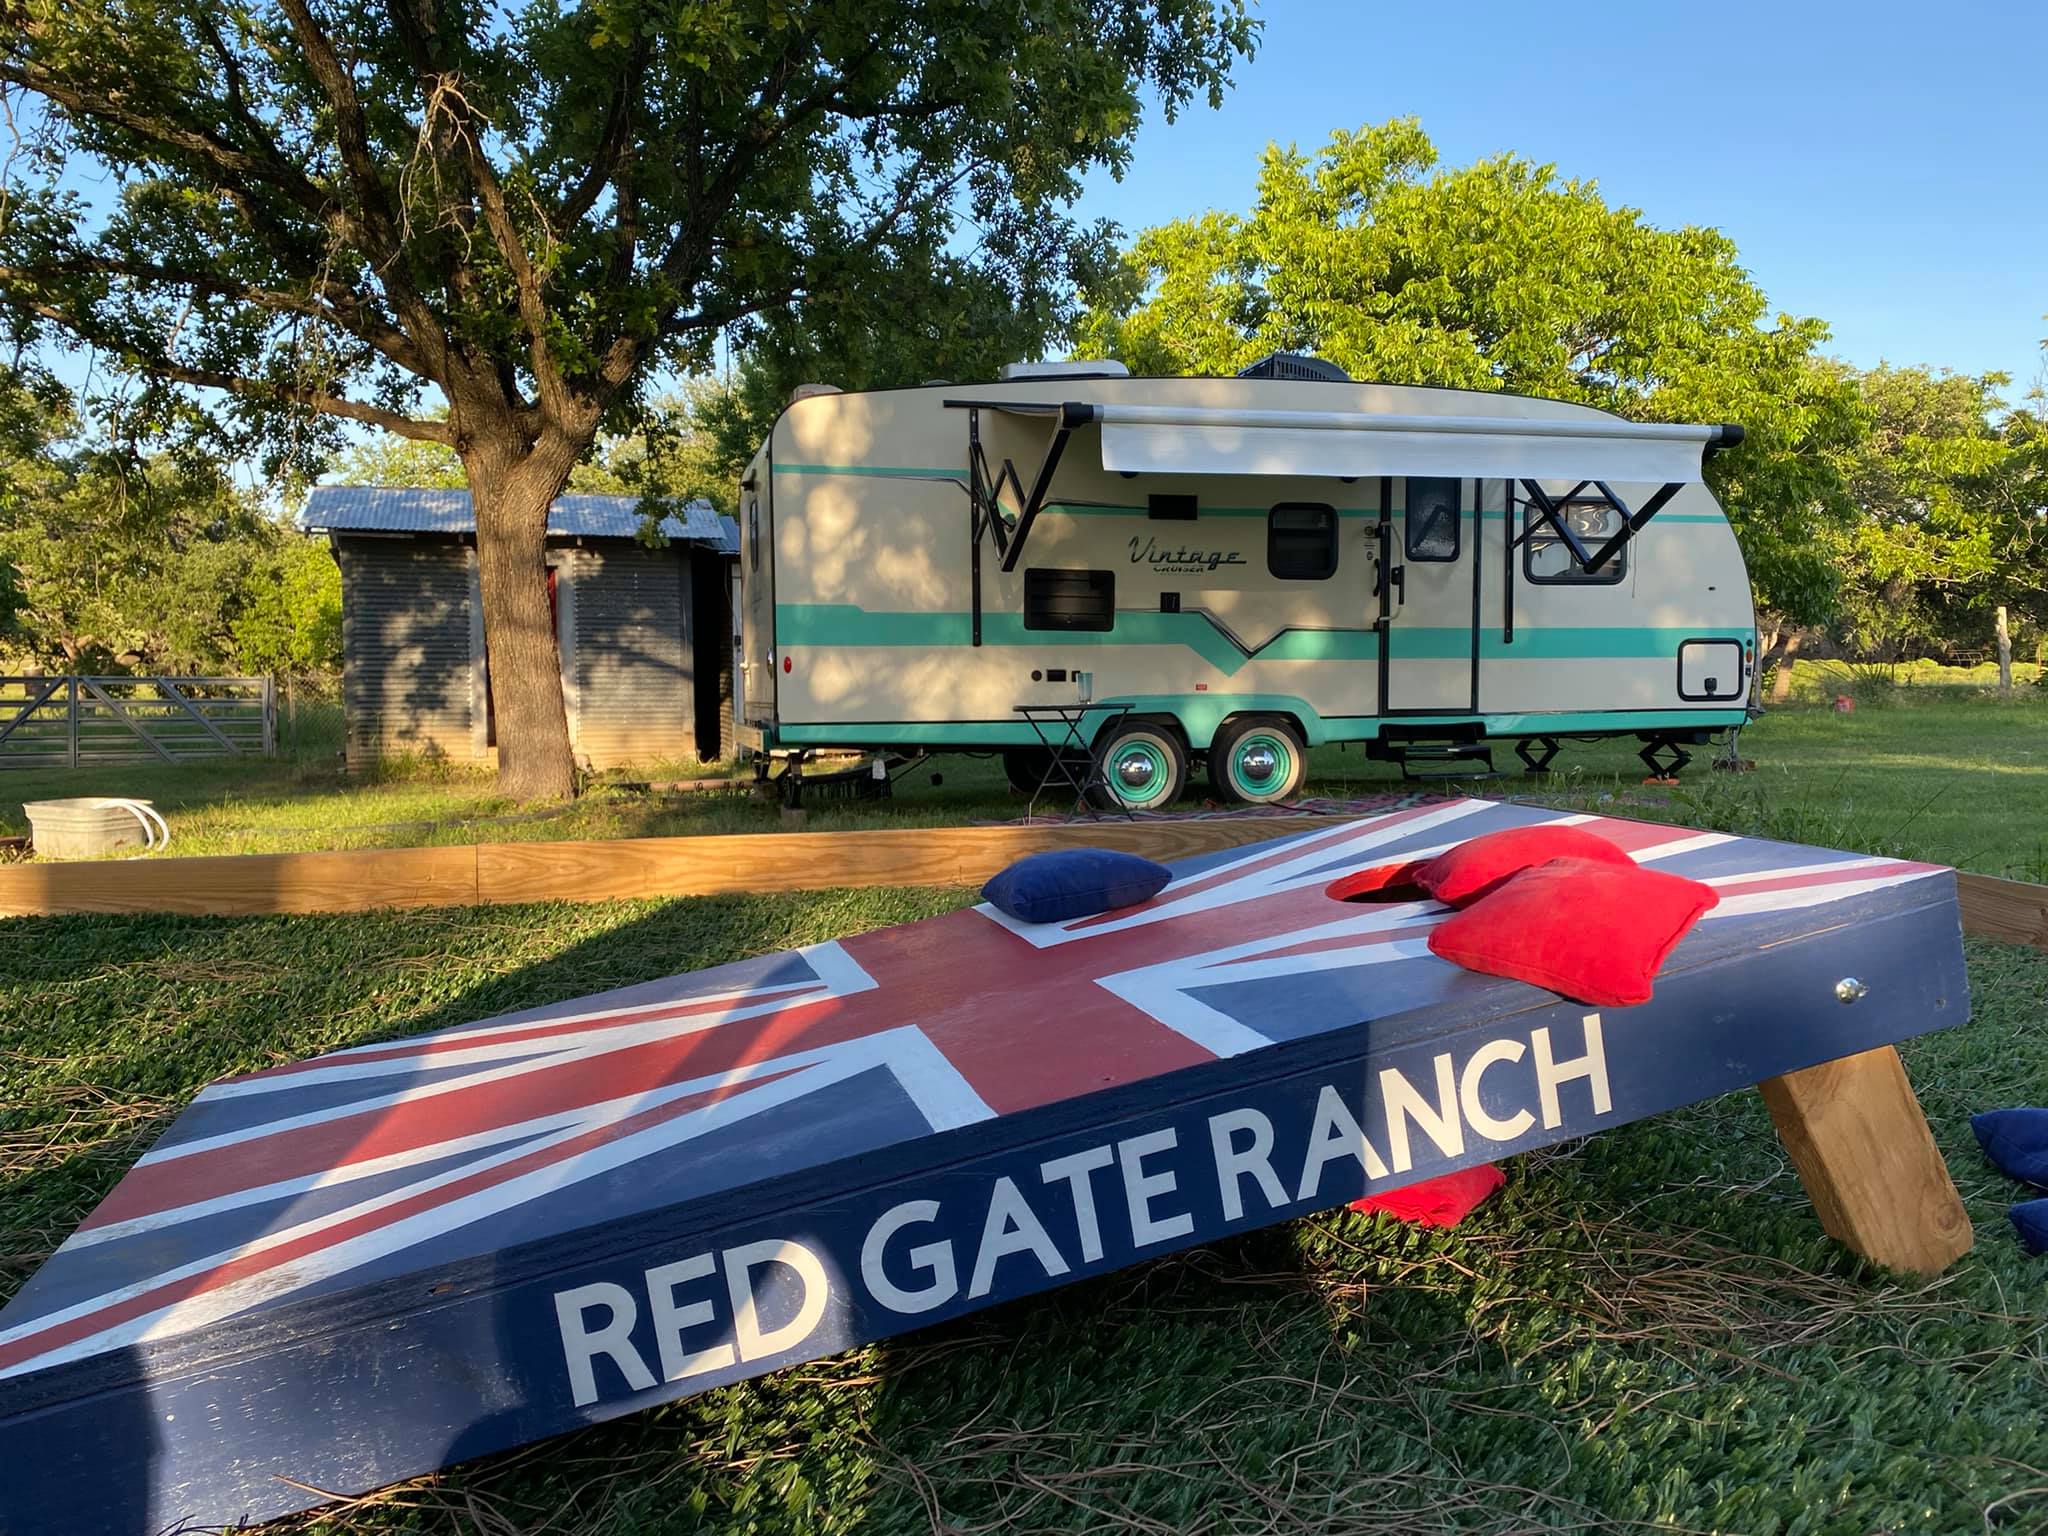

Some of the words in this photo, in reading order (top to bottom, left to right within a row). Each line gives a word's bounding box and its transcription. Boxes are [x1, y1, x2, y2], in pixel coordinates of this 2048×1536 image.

[1128, 536, 1247, 571] Vintage
[554, 1238, 829, 1408] RED
[860, 1127, 1195, 1314] GATE
[1207, 1013, 1613, 1222] RANCH
